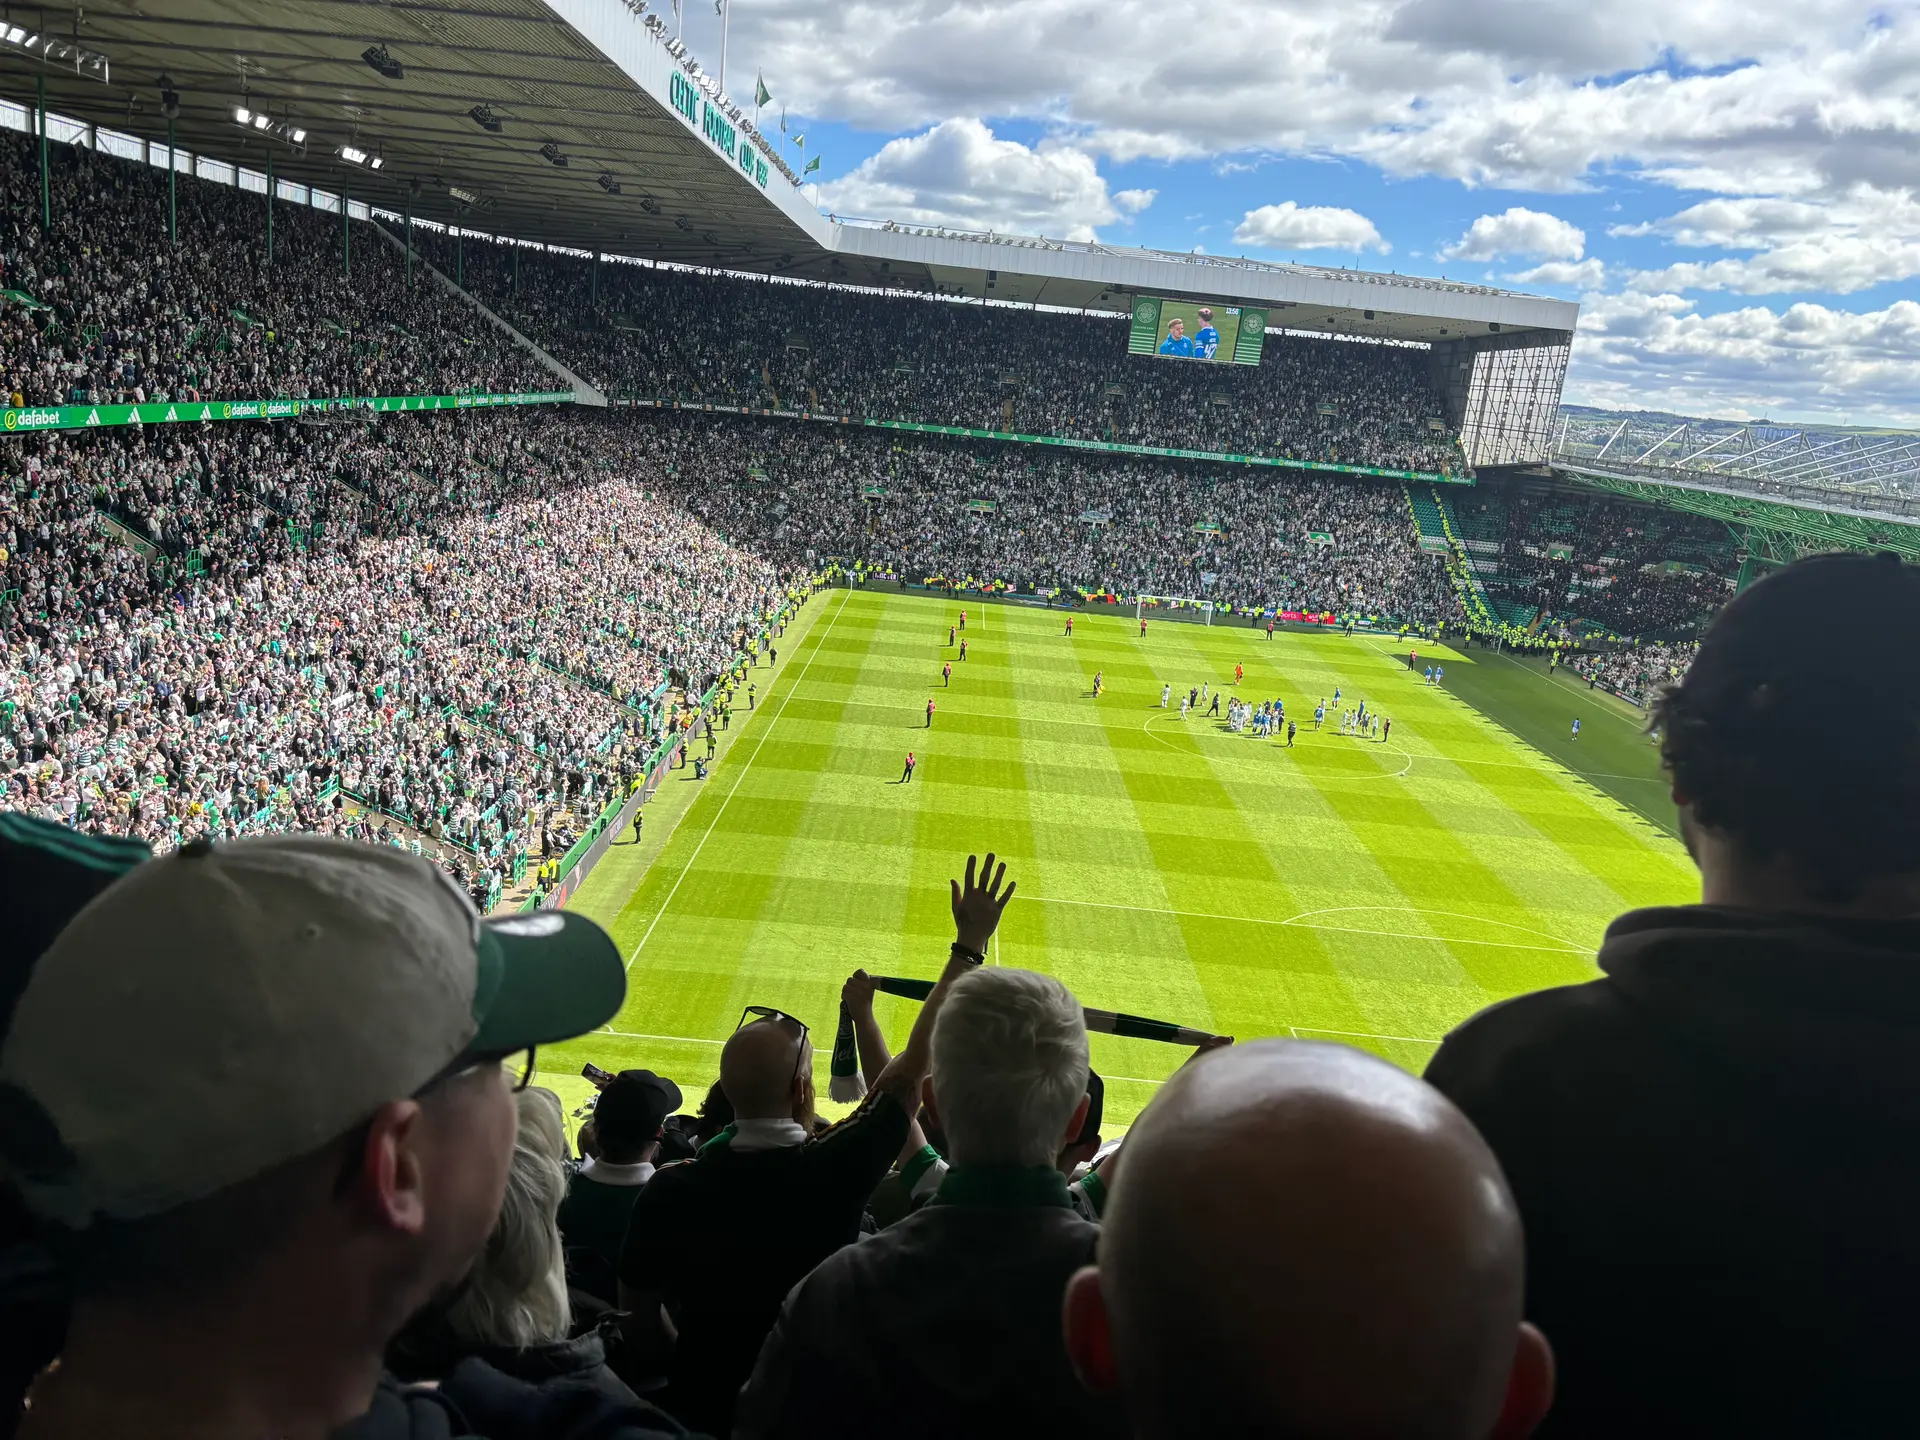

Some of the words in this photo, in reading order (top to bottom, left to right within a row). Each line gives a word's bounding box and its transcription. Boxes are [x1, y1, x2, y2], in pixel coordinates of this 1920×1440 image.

[670, 72, 700, 123] CELTIC
[703, 101, 735, 160] FOOTBALL
[739, 140, 755, 177] CLUB
[231, 402, 258, 418] dafabet
[267, 401, 292, 416] dafabet
[681, 402, 703, 410] MAGNERS
[17, 409, 60, 428] dafabet
[773, 410, 799, 418] MAGNERS
[812, 414, 839, 422] MAGNERS
[1263, 609, 1276, 619] sky
